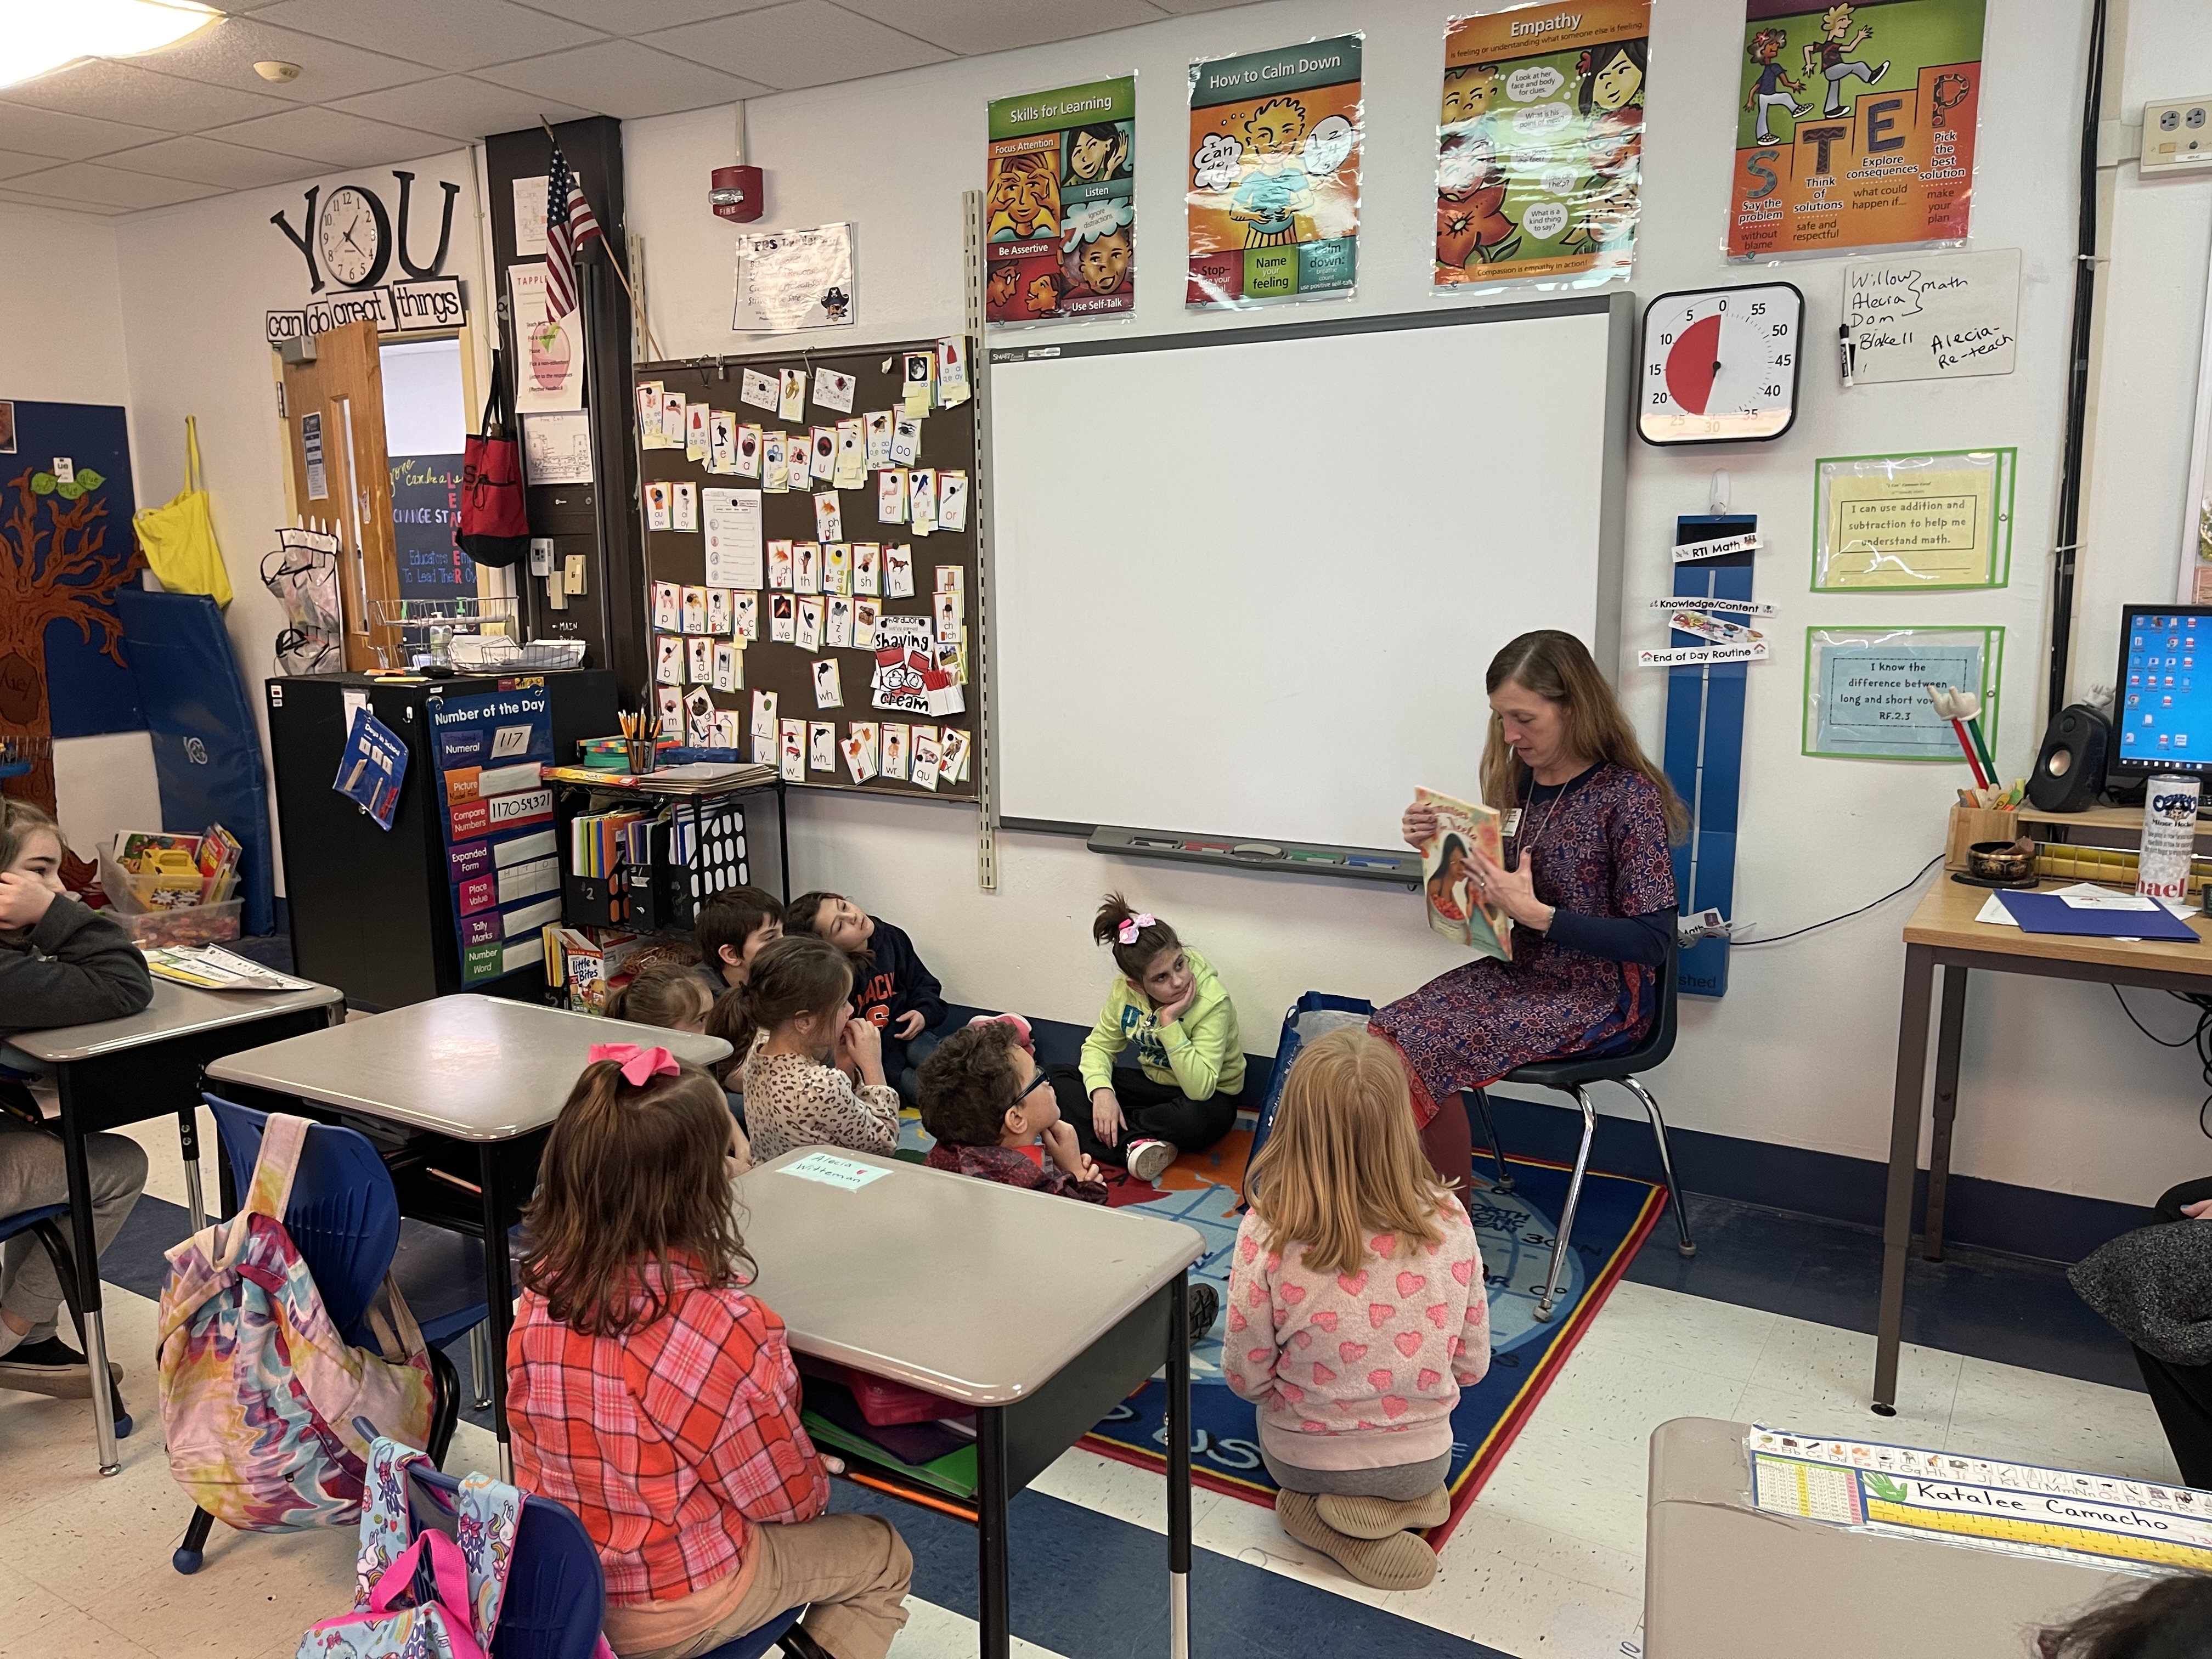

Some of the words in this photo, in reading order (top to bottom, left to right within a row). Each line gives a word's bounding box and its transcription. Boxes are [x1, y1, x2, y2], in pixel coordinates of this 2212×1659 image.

[1511, 13, 1582, 37] Empathy
[1458, 47, 1480, 58] feeling
[1490, 38, 1539, 53] understanding
[1542, 35, 1559, 44] what
[1561, 30, 1593, 41] someone
[1210, 72, 1241, 89] How
[1243, 69, 1259, 82] to
[1262, 62, 1295, 80] Calm
[1299, 55, 1341, 73] Down
[1516, 72, 1531, 82] Look
[1511, 81, 1524, 89] face
[1539, 77, 1555, 87] body
[1011, 106, 1039, 123] Skills
[1042, 104, 1058, 118] for
[1060, 96, 1112, 115] Learning
[1934, 132, 1955, 142] Pick
[995, 144, 1016, 154] Focus
[1017, 138, 1053, 151] Attention
[1936, 144, 1954, 154] the
[1201, 146, 1233, 163] can
[1863, 156, 1904, 168] Explore
[1932, 156, 1956, 167] best
[1846, 165, 1918, 179] consequences
[1919, 168, 1965, 180] solution
[1806, 177, 1835, 188] Think
[1085, 186, 1109, 198] Listen
[1814, 189, 1825, 199] of
[1854, 187, 1877, 197] what
[1880, 184, 1907, 195] could
[1927, 189, 1954, 199] make
[719, 207, 736, 215] FIRE
[1742, 200, 1760, 211] Say
[1764, 199, 1781, 208] the
[1794, 201, 1843, 212] solutions
[1852, 200, 1888, 210] happen
[1928, 202, 1950, 212] your
[1088, 208, 1105, 219] Ignore
[1531, 210, 1548, 218] What
[1739, 210, 1782, 224] problem
[1928, 214, 1950, 224] plan
[1084, 213, 1113, 229] distractions
[1529, 217, 1543, 225] kind
[1544, 216, 1561, 226] thing
[1797, 222, 1815, 230] safe
[1819, 220, 1837, 229] and
[1542, 223, 1556, 232] say?
[1741, 230, 1778, 240] without
[1793, 230, 1839, 241] respectful
[754, 239, 778, 251] FPS
[999, 246, 1010, 256] Be
[1011, 244, 1048, 255] Assertive
[1745, 240, 1773, 250] blame
[1256, 257, 1286, 268] Name
[1310, 257, 1345, 268] down:
[1477, 267, 1516, 278] Compassion
[1523, 263, 1554, 274] empathy
[1564, 259, 1587, 269] action!
[1263, 267, 1279, 277] your
[1252, 277, 1289, 290] feeling
[1852, 269, 1911, 289] Willow
[1921, 276, 1968, 292] math
[1310, 282, 1330, 290] positive
[1072, 302, 1087, 312] Use
[1090, 298, 1122, 310] Self-Talk
[1719, 300, 1726, 312] 0
[1853, 292, 1905, 309] Alecia
[269, 315, 303, 337] can
[309, 304, 329, 334] do
[334, 292, 386, 327] great
[398, 289, 459, 327] things
[1686, 309, 1694, 321] 5
[1751, 303, 1765, 315] 55
[1850, 313, 1894, 328] Dom
[1772, 324, 1787, 336] 50
[1661, 334, 1672, 345] 10
[1775, 354, 1791, 366] 45
[1650, 364, 1661, 375] 15
[1764, 385, 1780, 397] 40
[1652, 392, 1667, 404] 20
[885, 505, 896, 515] ar
[1852, 505, 1857, 514] I
[1900, 501, 1943, 511] addition
[1946, 499, 1965, 509] and
[393, 508, 431, 523] CHANGE
[946, 511, 957, 520] or
[1849, 521, 1906, 531] subtraction
[1910, 519, 1921, 528] to
[1925, 517, 1948, 529] help
[1861, 536, 1917, 546] understand
[1921, 534, 1951, 545] math.
[1693, 547, 1708, 557] RTI
[1712, 541, 1740, 554] Math
[1660, 600, 1759, 613] Knowledge/Content
[876, 631, 928, 651] shaving
[1654, 654, 1672, 662] End
[1713, 649, 1751, 658] Routine
[1871, 663, 1875, 672] I
[1879, 663, 1905, 672] know
[1909, 663, 1926, 672] the
[1848, 679, 1901, 687] difference
[1905, 679, 1947, 689] between
[881, 693, 928, 712] cream
[1840, 695, 1860, 707] long
[1865, 695, 1882, 704] and
[1886, 695, 1912, 704] short
[435, 708, 479, 725] Number
[483, 704, 495, 717] of
[499, 703, 519, 714] the
[522, 700, 545, 712] Day
[500, 732, 523, 748] 117
[446, 743, 480, 753] Numeral
[454, 781, 478, 791] Picture
[454, 809, 485, 821] Compare
[455, 820, 486, 832] Numbers
[452, 847, 487, 862] Expanded
[462, 863, 479, 872] Form
[469, 883, 487, 894] Place
[470, 895, 488, 906] Value
[472, 922, 487, 931] Tally
[472, 932, 493, 943] Marks
[469, 949, 498, 961] Number
[474, 963, 492, 974] Word
[573, 958, 590, 974] Little
[579, 969, 597, 981] Bites
[811, 1155, 851, 1167] Alecia
[797, 1163, 861, 1183] Witteman
[1917, 1482, 2027, 1511] Katalee
[2046, 1499, 2168, 1530] Camacho
